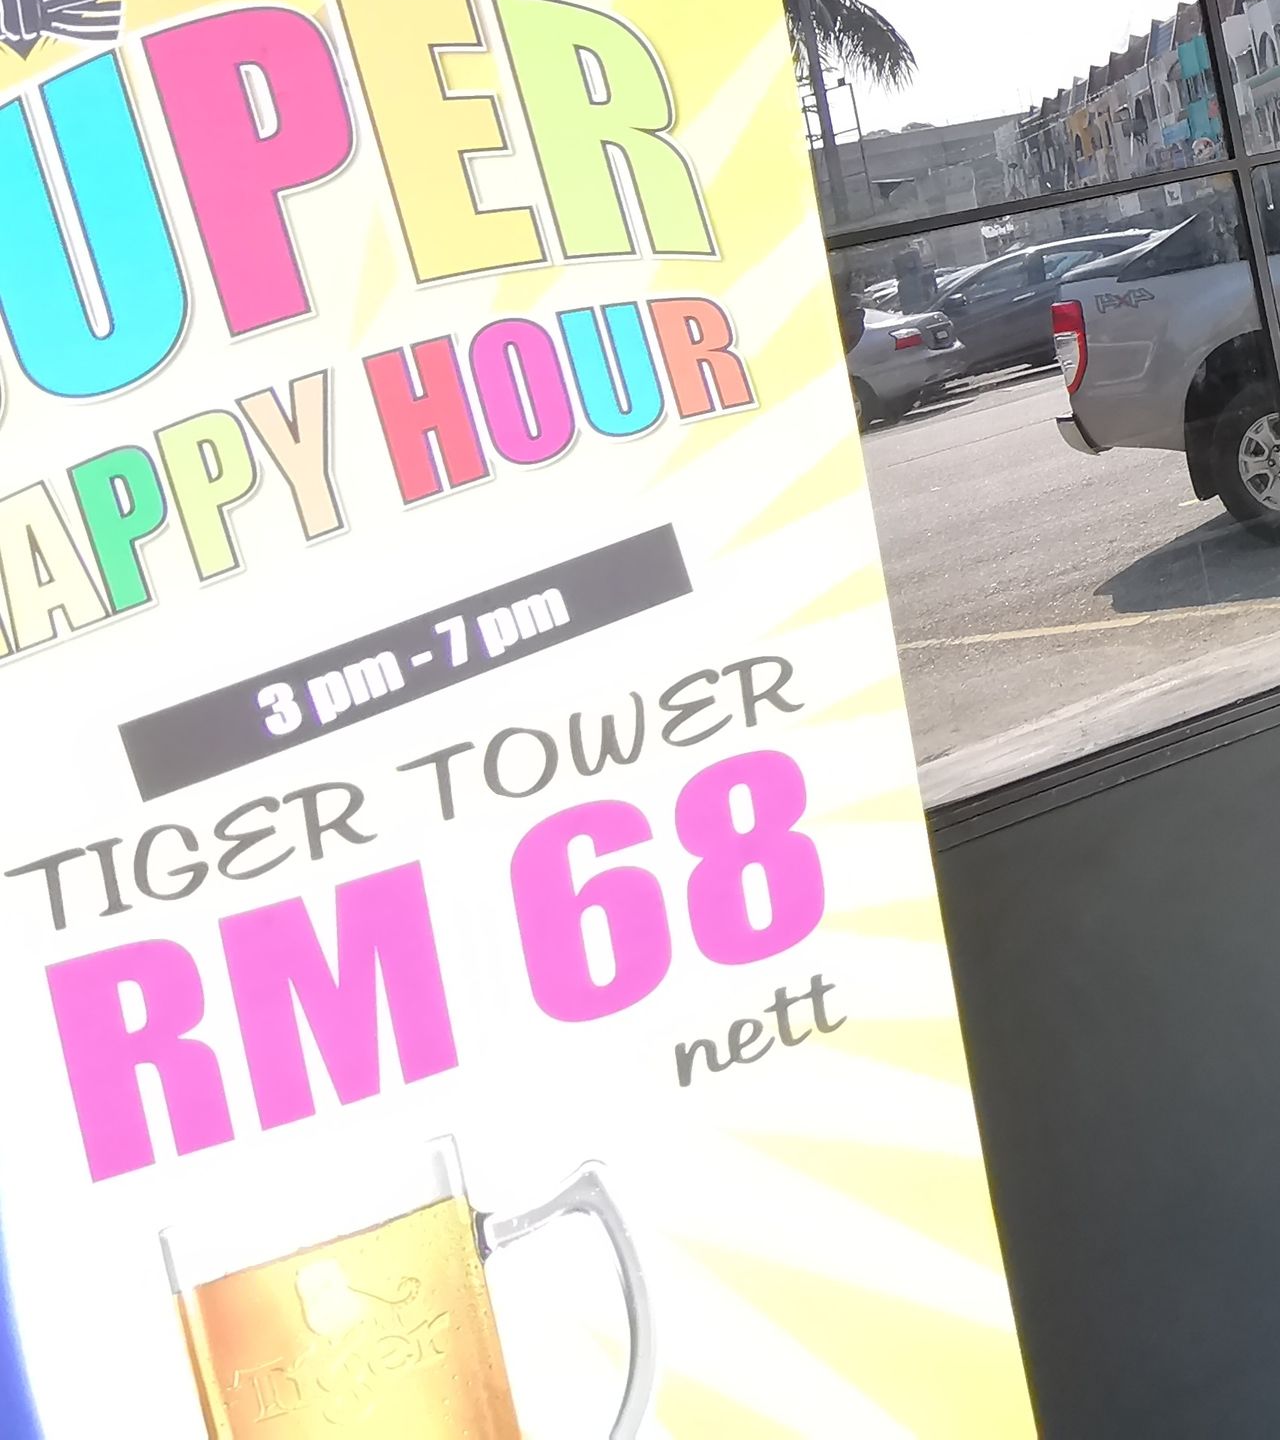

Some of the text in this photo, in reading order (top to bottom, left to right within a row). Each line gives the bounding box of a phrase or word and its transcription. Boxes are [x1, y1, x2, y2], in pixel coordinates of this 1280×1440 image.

[0, 296, 759, 660] APPY HOUR
[3, 654, 805, 931] TIGER TOWER
[256, 681, 302, 736] 3
[306, 651, 405, 726] pm
[434, 615, 468, 667] 7
[476, 587, 571, 658] pm
[44, 749, 825, 1184] RM 68
[675, 974, 847, 1087] nett
